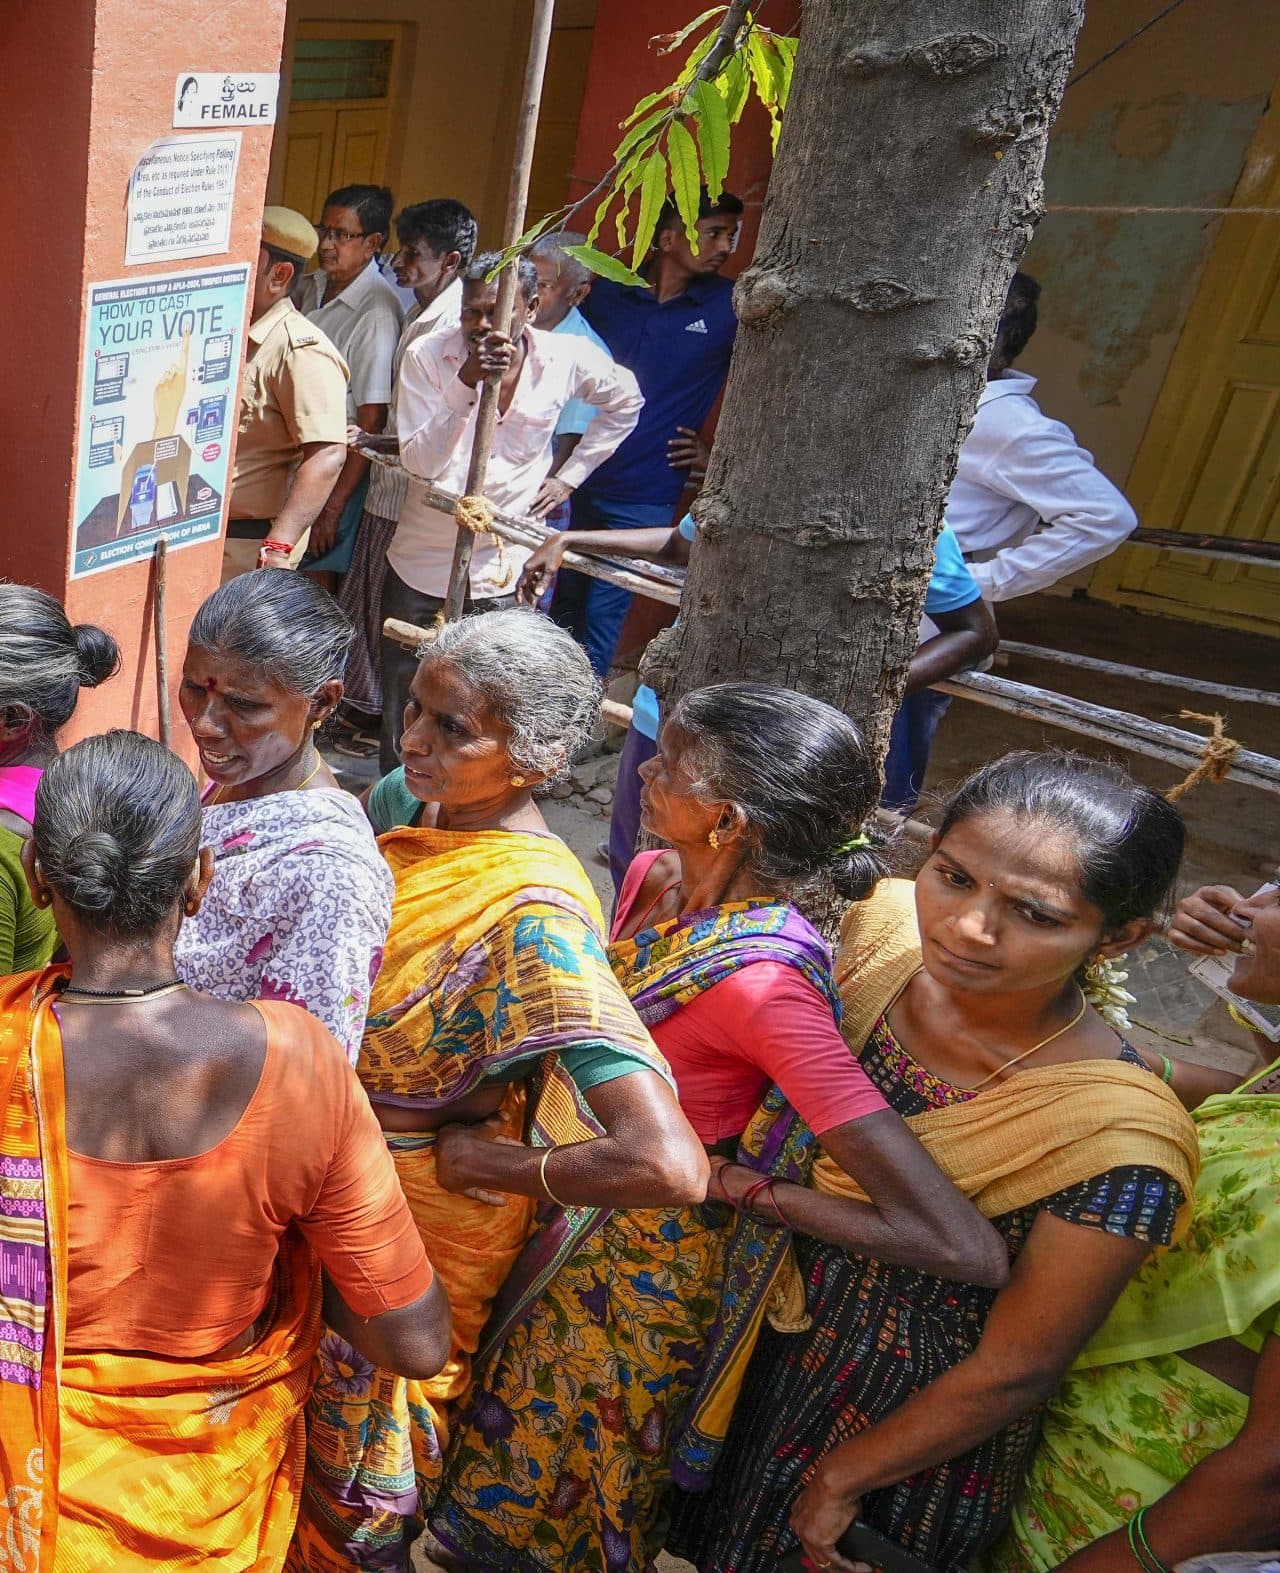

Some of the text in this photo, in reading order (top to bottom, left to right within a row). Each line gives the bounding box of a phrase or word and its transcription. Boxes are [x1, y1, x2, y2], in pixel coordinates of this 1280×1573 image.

[200, 103, 269, 120] FEMALE
[99, 294, 193, 321] HOW TO CAST
[99, 304, 224, 346] YOUR VOTE
[100, 542, 134, 560] ELECTION
[180, 528, 191, 540] OF
[191, 521, 211, 535] INDIA
